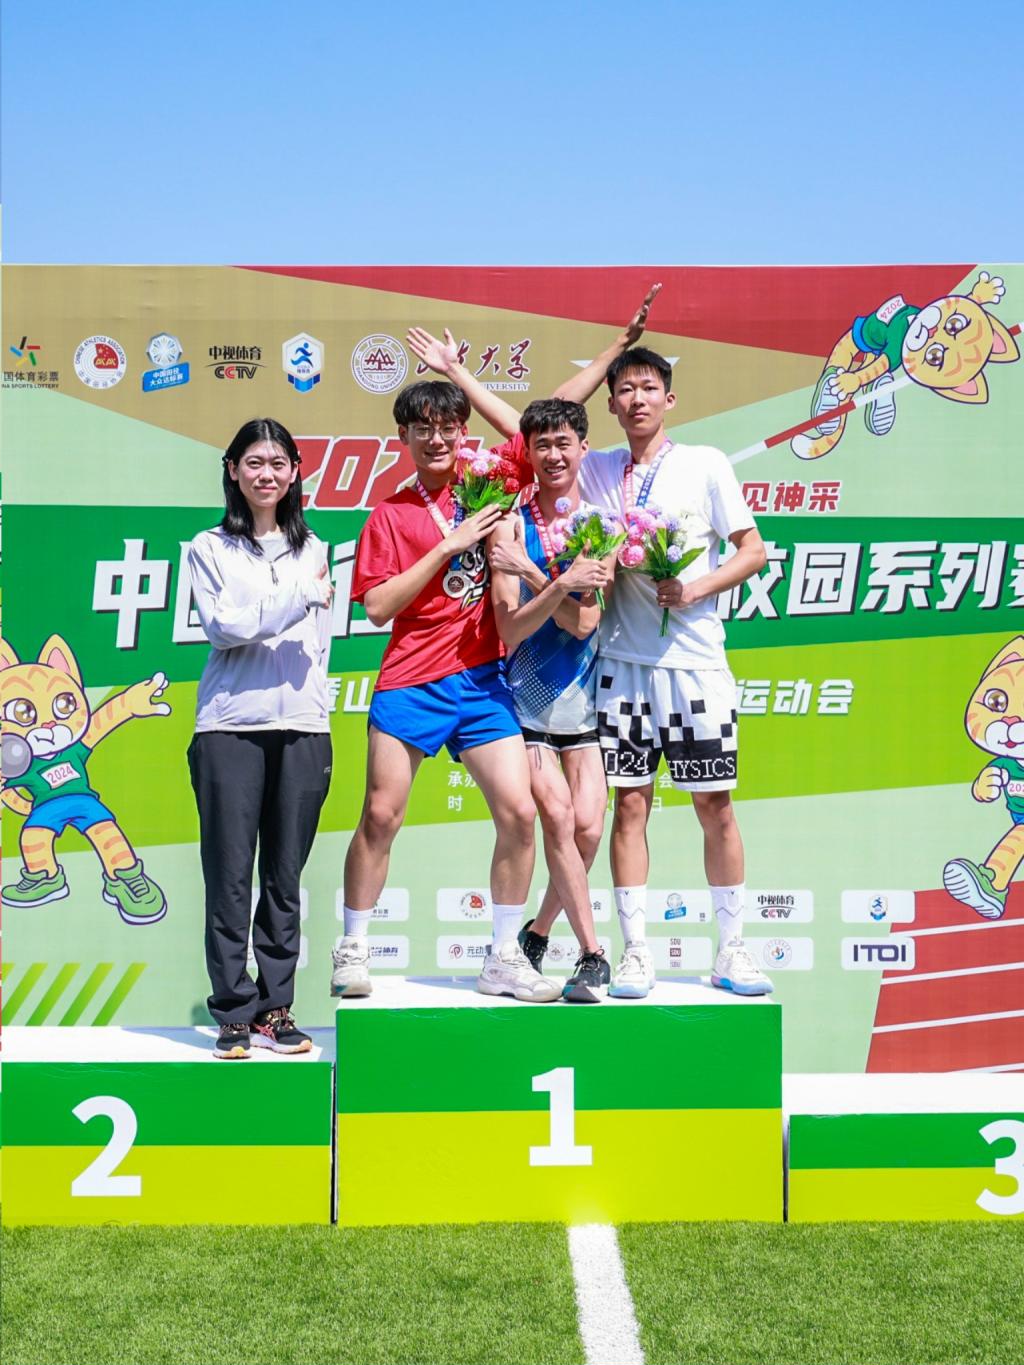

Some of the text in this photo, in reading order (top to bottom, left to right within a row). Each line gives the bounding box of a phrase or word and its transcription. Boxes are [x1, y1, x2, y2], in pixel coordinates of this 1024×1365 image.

[879, 299, 902, 319] 2024
[209, 346, 262, 361] 中视体育
[215, 366, 257, 379] CCTV
[743, 481, 840, 512] 见神采
[717, 541, 1024, 620] 校园系列
[736, 679, 855, 715] 运动会
[47, 765, 74, 784] 2024
[667, 757, 736, 780] HYSICS
[761, 909, 792, 918] CCTV
[853, 945, 907, 962] ITOI
[529, 1067, 592, 1166] 1
[71, 1096, 141, 1196] 2
[976, 1119, 1024, 1215] 3
